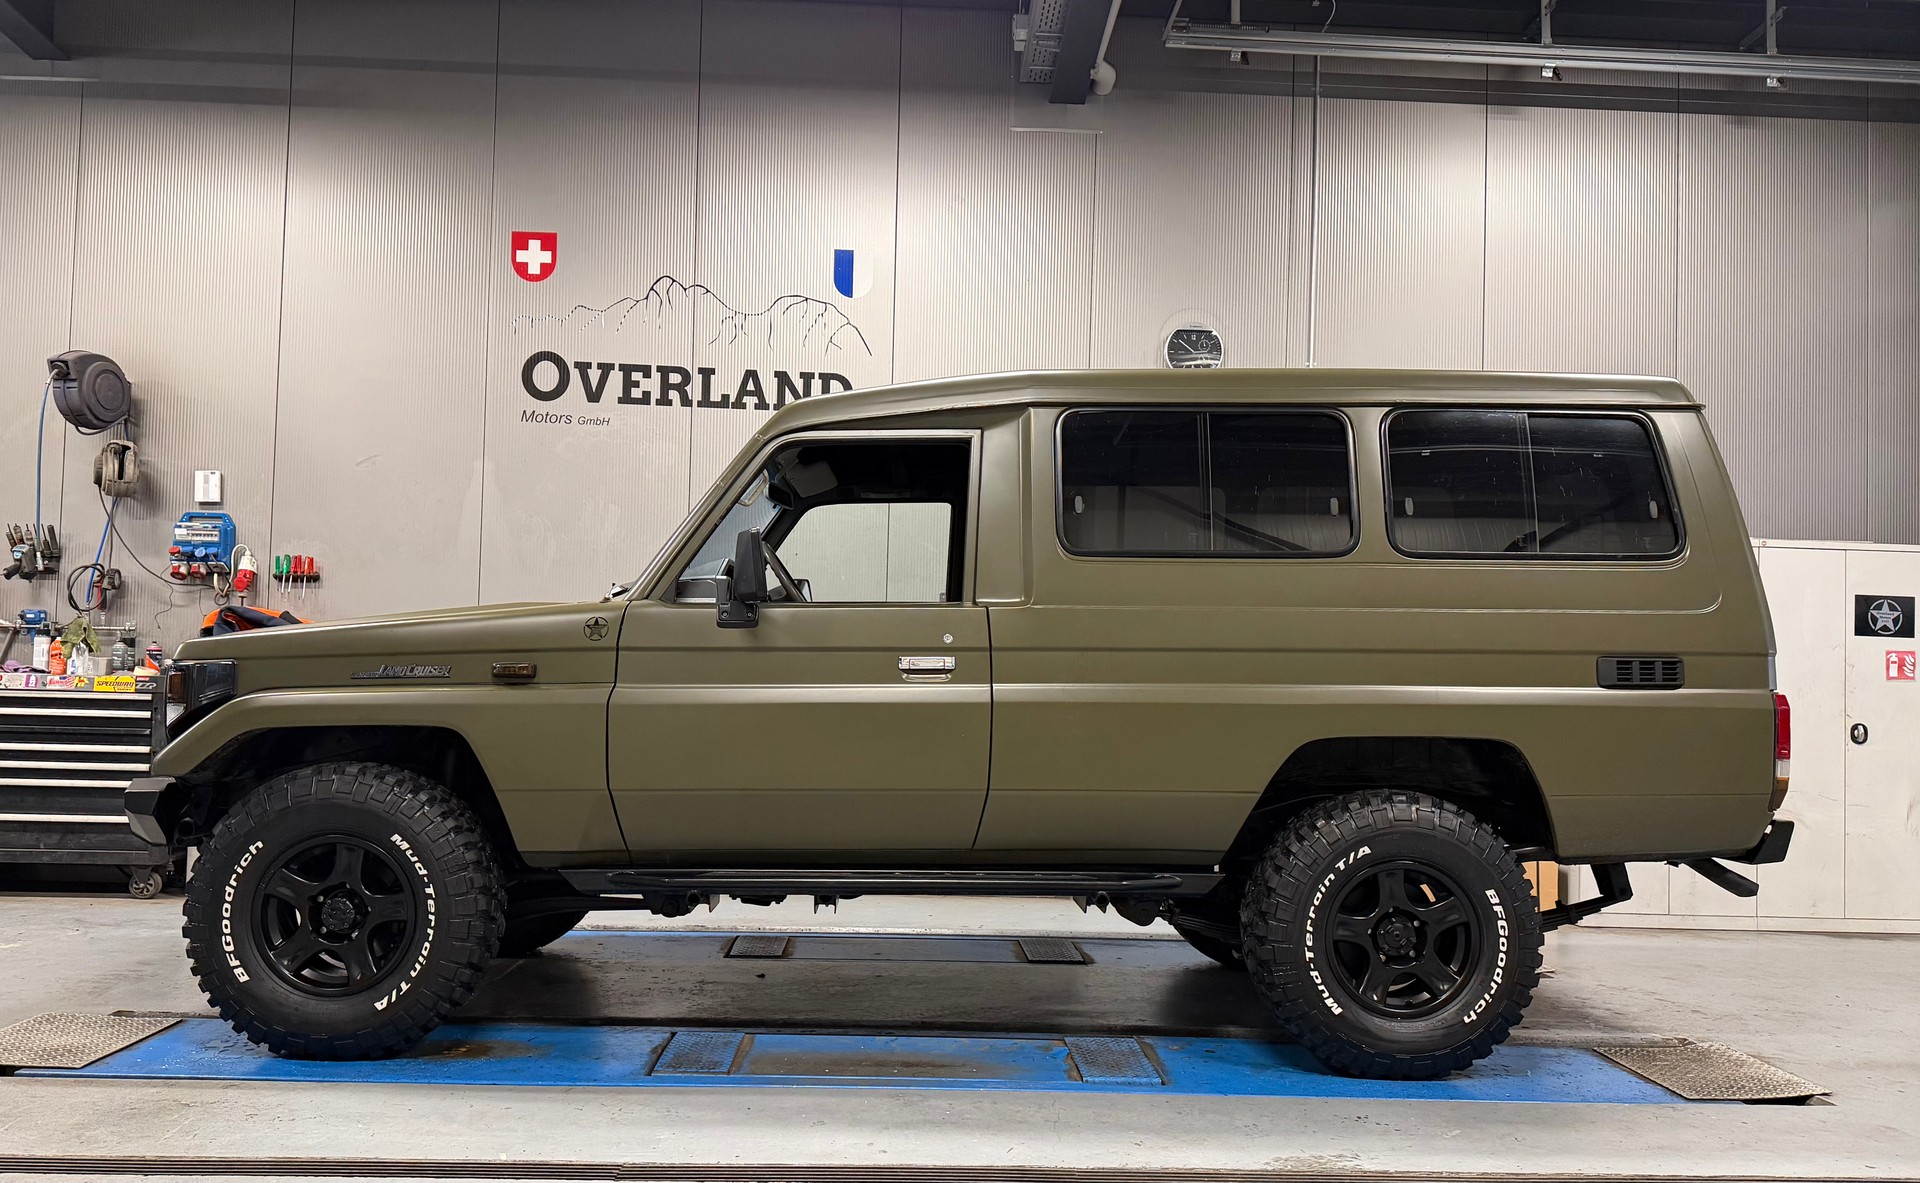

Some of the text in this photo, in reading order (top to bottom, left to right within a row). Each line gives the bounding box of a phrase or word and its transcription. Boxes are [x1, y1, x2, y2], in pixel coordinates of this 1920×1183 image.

[520, 409, 612, 426] Motors GmbH
[221, 840, 265, 984] BFGoodrich
[373, 832, 438, 1012] Mud-Terrain T/A
[1304, 844, 1373, 1017] Mud-Terrain T/A
[1463, 887, 1510, 1025] BFGoodrich
